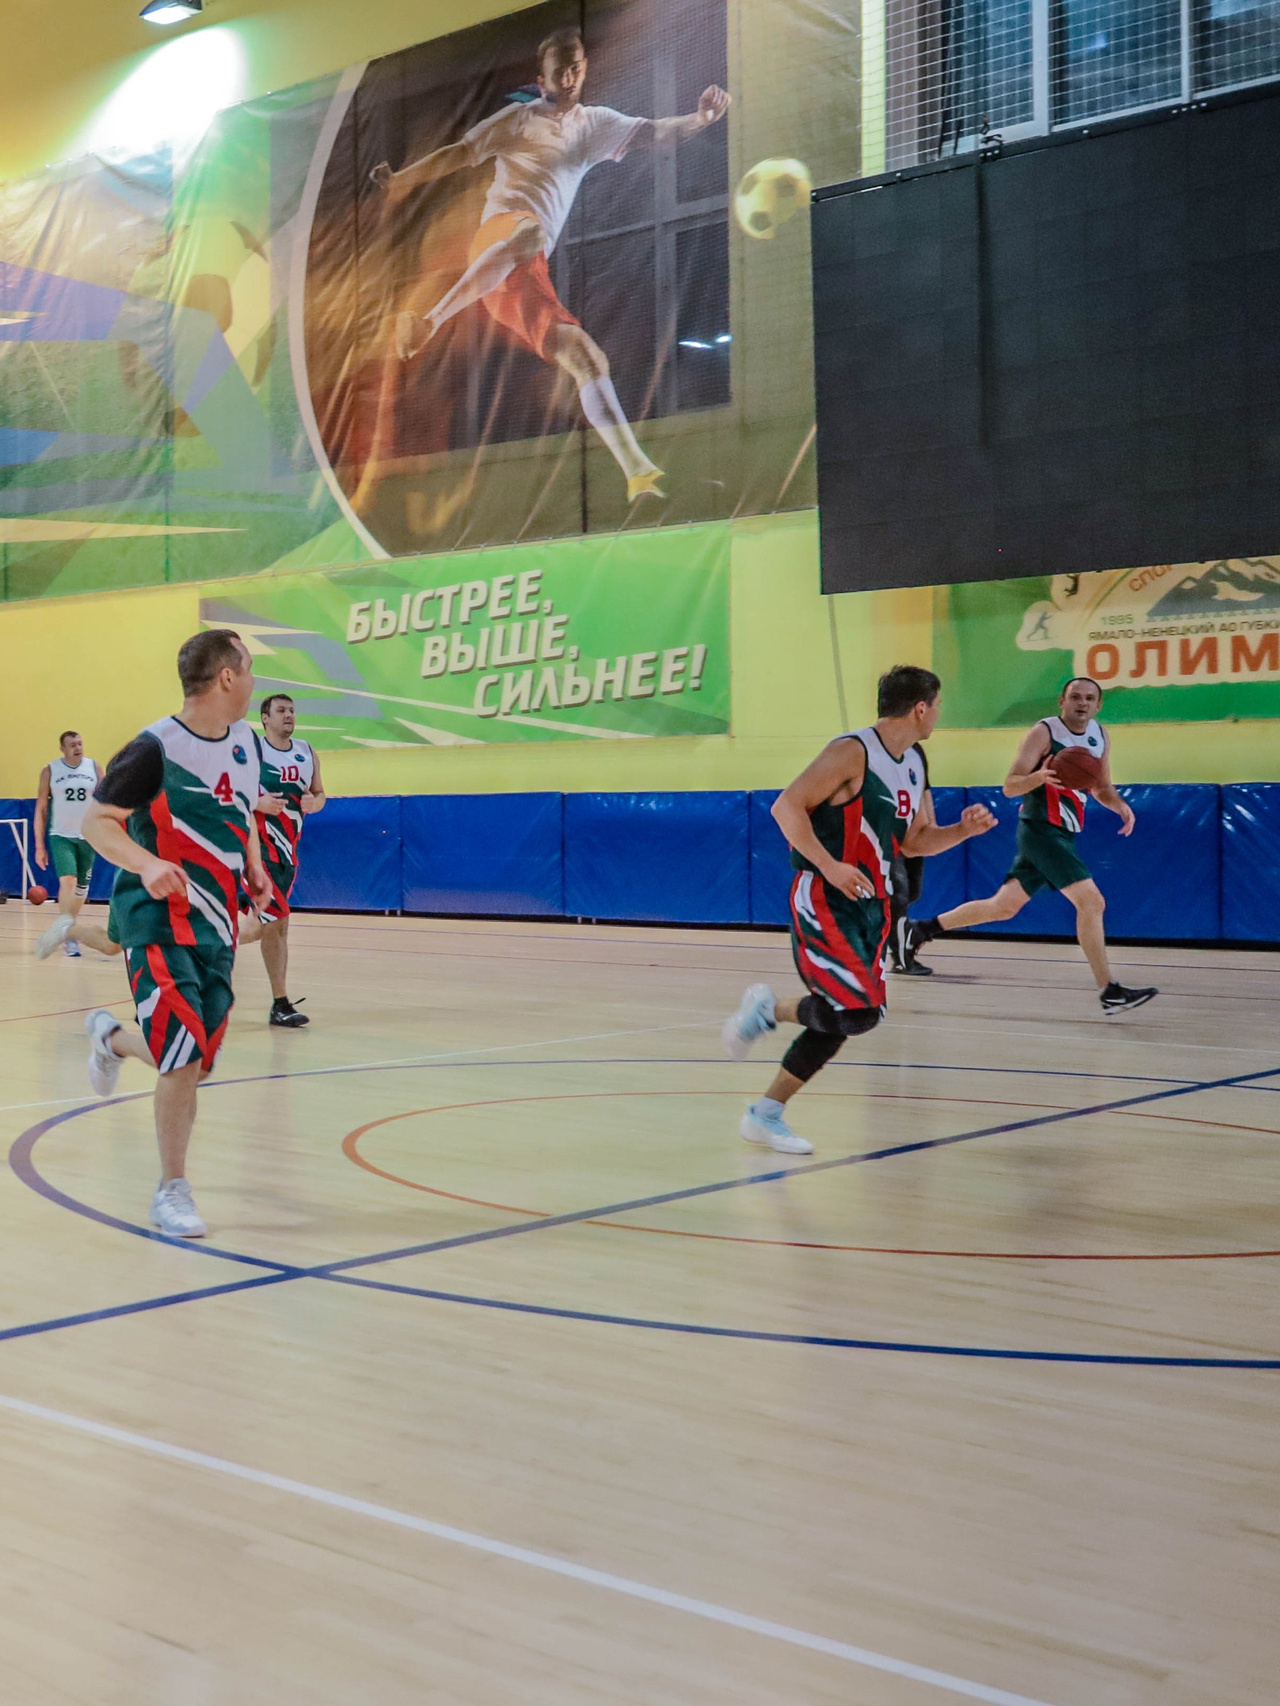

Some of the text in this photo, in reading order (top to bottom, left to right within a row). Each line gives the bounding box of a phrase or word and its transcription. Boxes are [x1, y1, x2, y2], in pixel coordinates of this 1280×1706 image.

[346, 569, 553, 644] БЫСТРЕЕ,
[421, 614, 579, 679] ВЫШЕ,
[1088, 621, 1215, 641] ЯМАЛО-НЕНЕЦКИЙ
[1220, 620, 1237, 633] АО
[1086, 632, 1280, 681] ОЛИМ
[473, 644, 707, 718] СИЛЬНЕЕ!
[214, 772, 234, 803] 4
[280, 765, 300, 782] 10
[65, 788, 87, 801] 28
